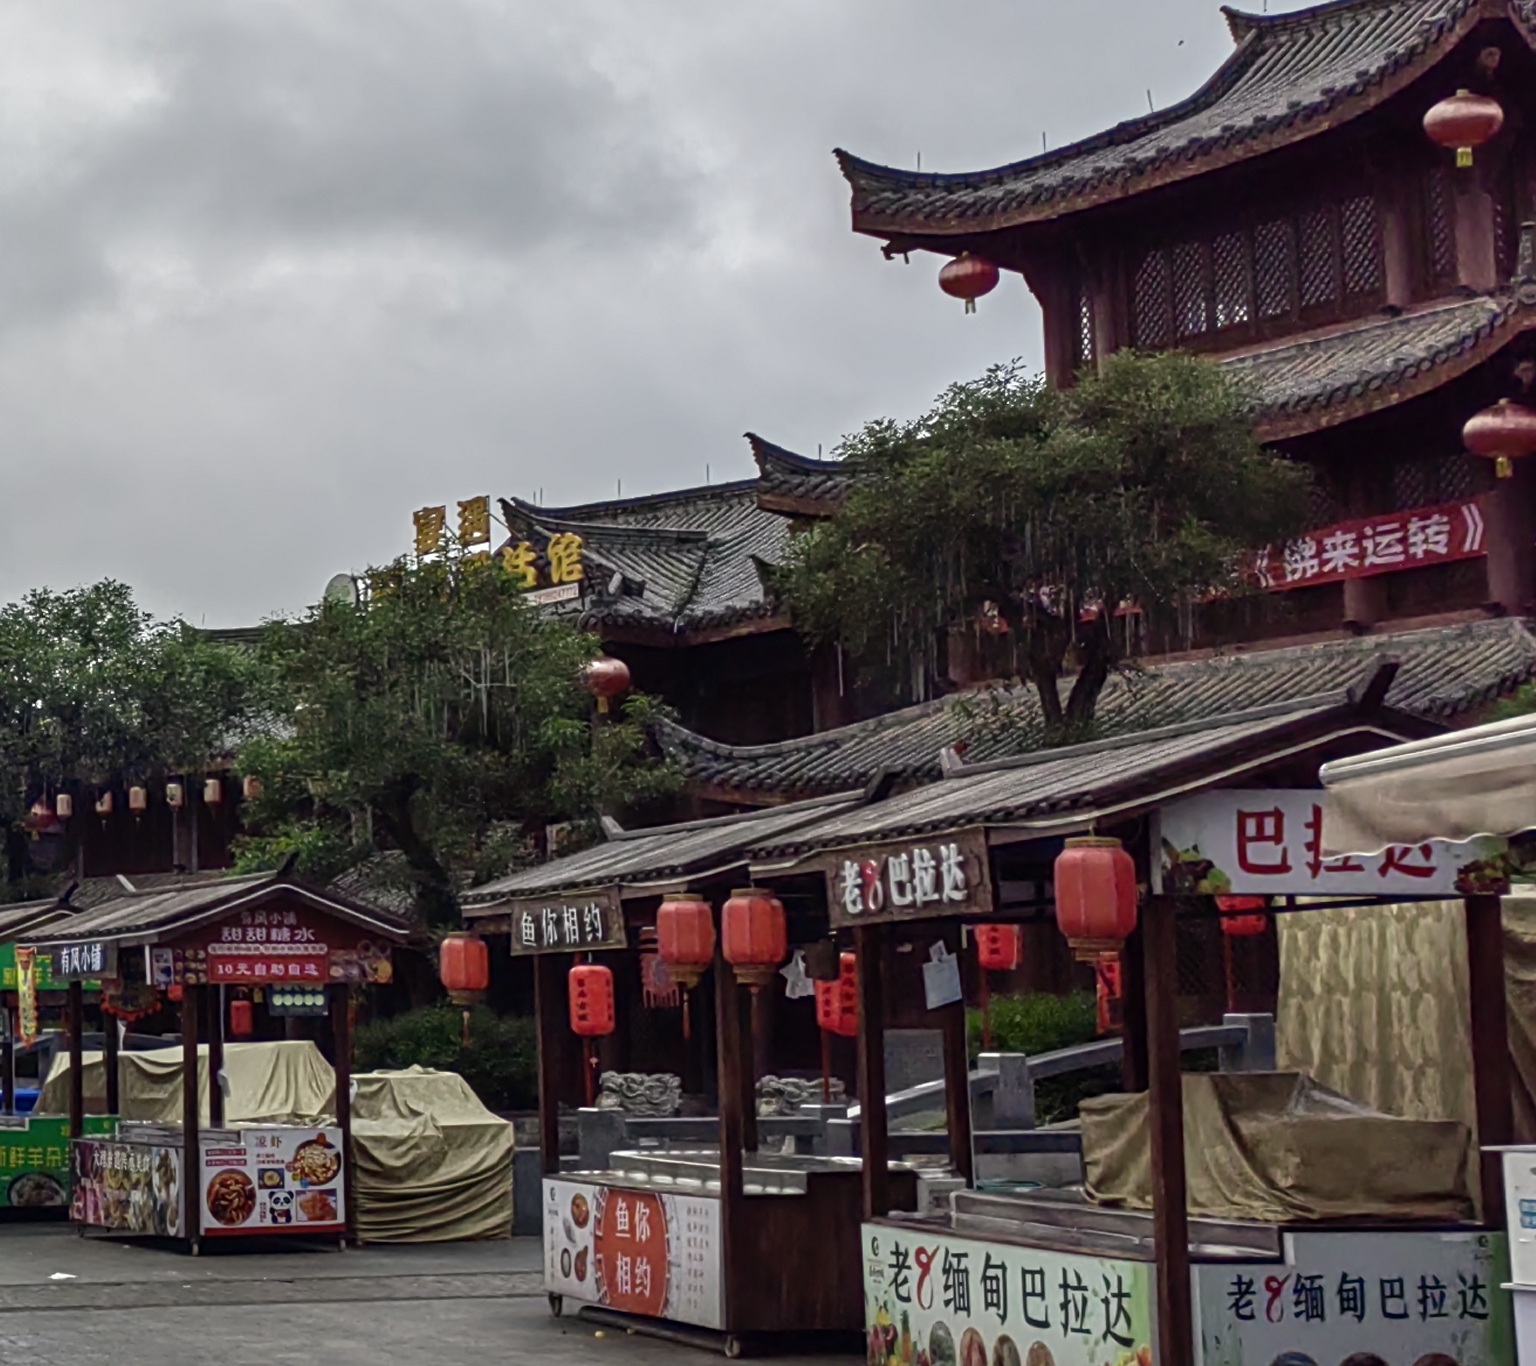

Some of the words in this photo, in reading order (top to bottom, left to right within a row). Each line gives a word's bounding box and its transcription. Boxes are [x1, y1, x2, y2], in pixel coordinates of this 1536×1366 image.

[221, 927, 315, 942] 甜甜糖水
[521, 901, 603, 947] 鱼你相约
[61, 943, 104, 974] 有风小铺
[615, 1197, 652, 1243] 鱼你
[615, 1251, 652, 1297] 相约
[888, 1240, 1135, 1348] 老8缅甸巴拉达
[1227, 1271, 1489, 1323] 老8缅甸巴拉达
